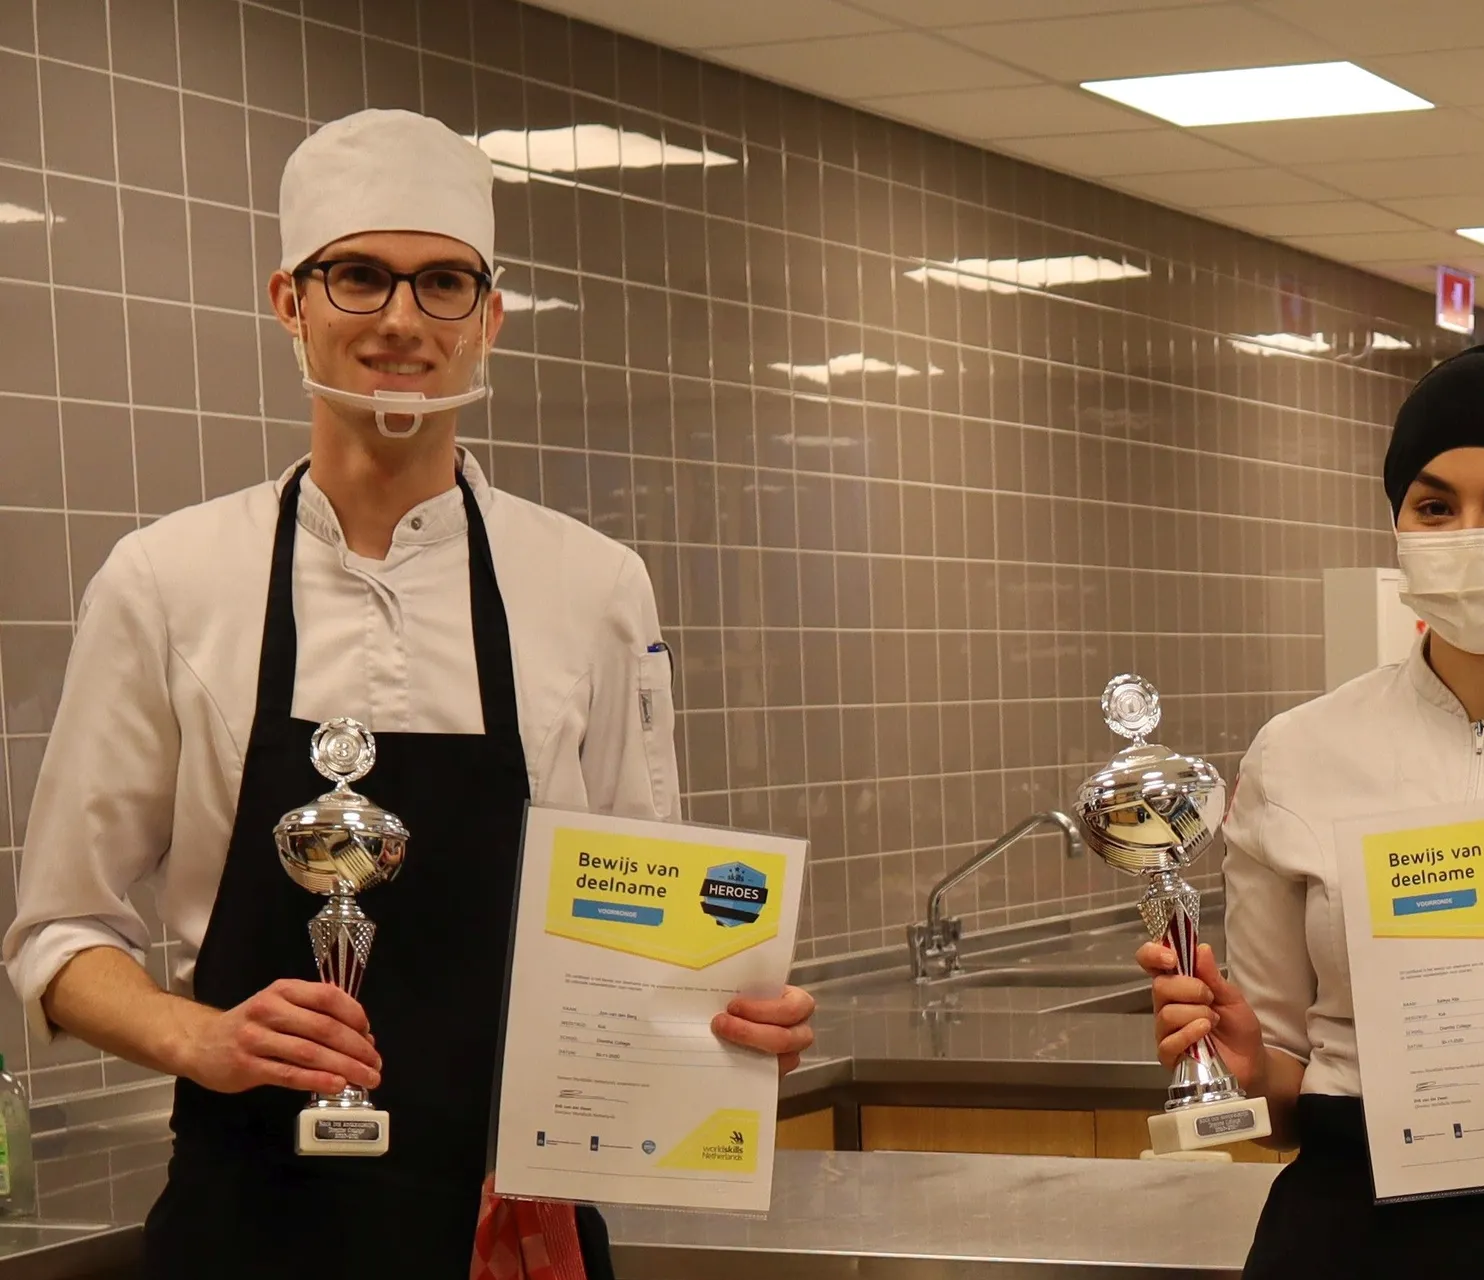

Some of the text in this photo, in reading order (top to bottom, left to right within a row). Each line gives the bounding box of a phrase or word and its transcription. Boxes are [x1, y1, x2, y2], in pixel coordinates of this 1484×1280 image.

[578, 852, 679, 878] Bewijs van
[1388, 844, 1482, 867] Bewijs van
[576, 874, 667, 898] deelname
[1391, 866, 1475, 888] deelname
[709, 884, 759, 900] HEROES
